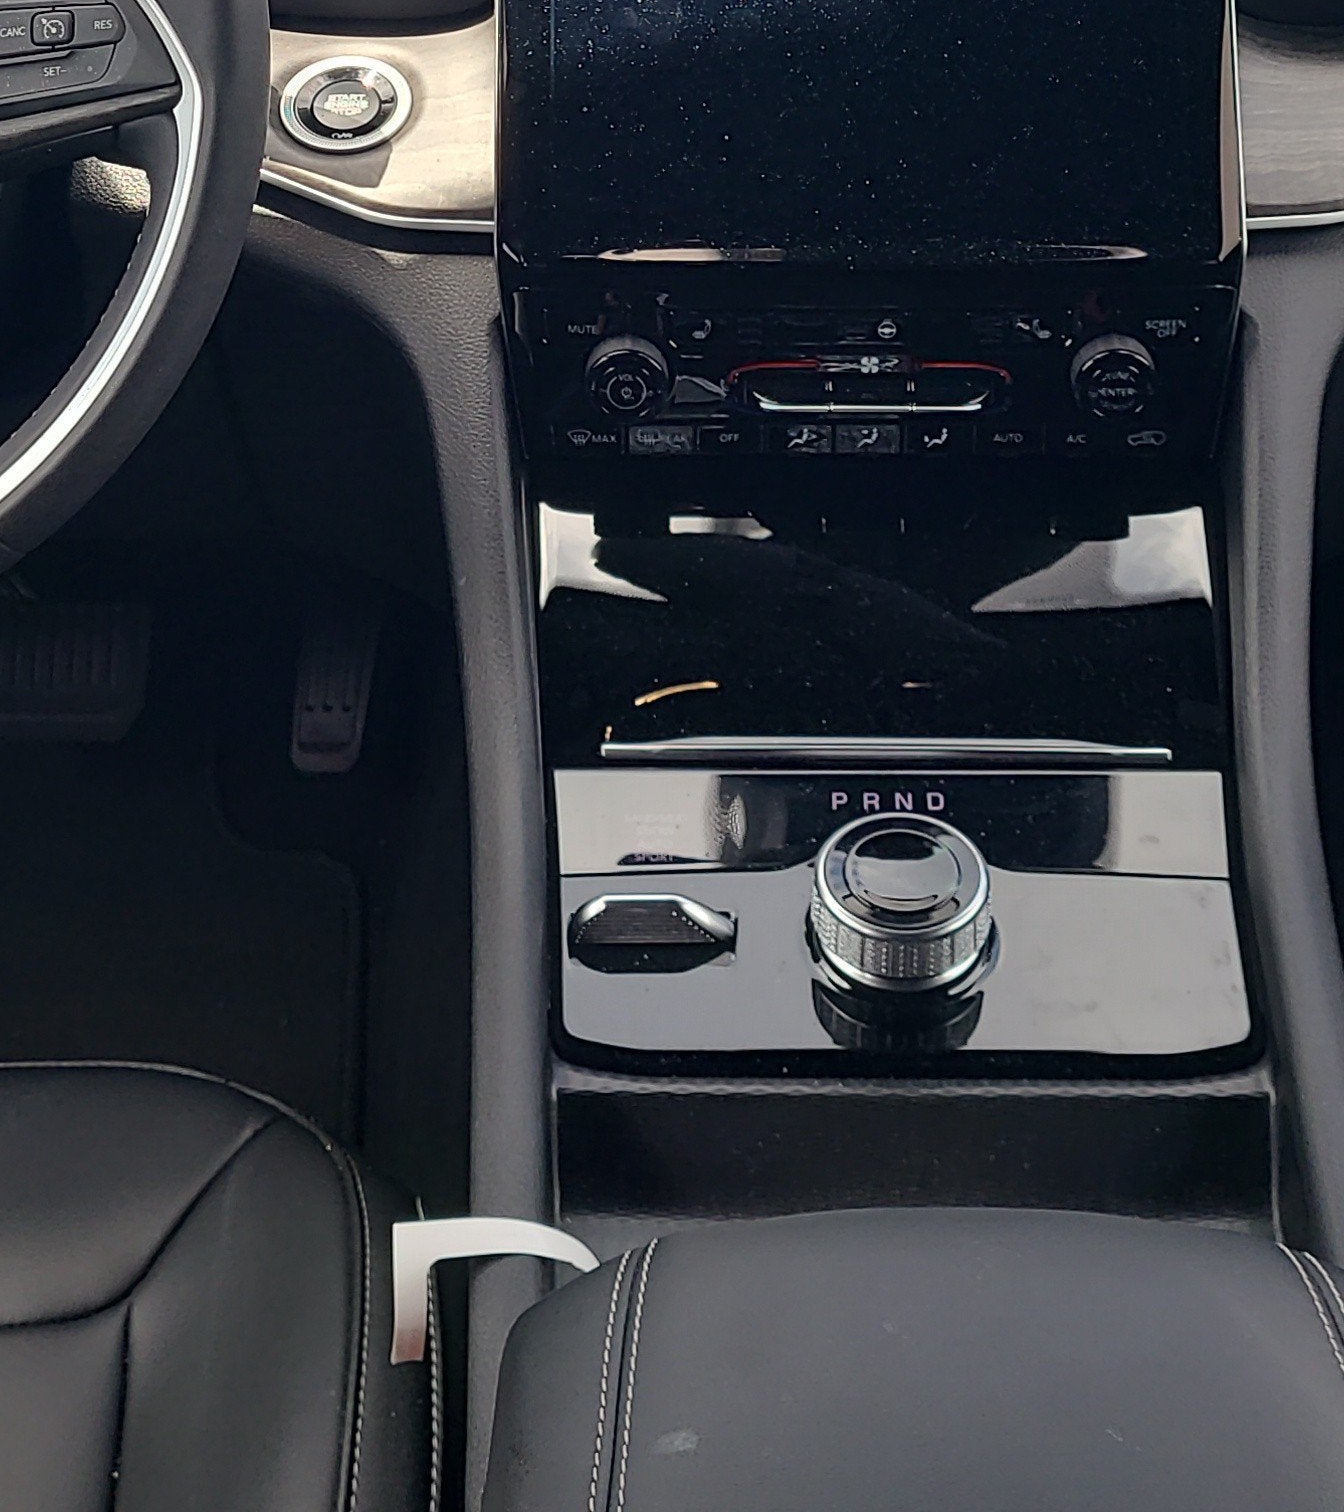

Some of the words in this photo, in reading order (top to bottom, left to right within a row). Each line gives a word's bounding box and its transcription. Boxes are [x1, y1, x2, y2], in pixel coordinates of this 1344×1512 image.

[93, 20, 113, 30] RES
[0, 26, 26, 38] CANC
[328, 93, 366, 101] START
[1145, 318, 1187, 329] SCREEN
[1156, 328, 1178, 338] OFF
[592, 434, 617, 443] MAX
[718, 432, 741, 443] OFF
[992, 432, 1025, 444] AUTO
[1065, 433, 1088, 444] A/C
[832, 792, 849, 810] P
[863, 793, 880, 811] R
[895, 793, 913, 810] N
[927, 792, 945, 810] D
